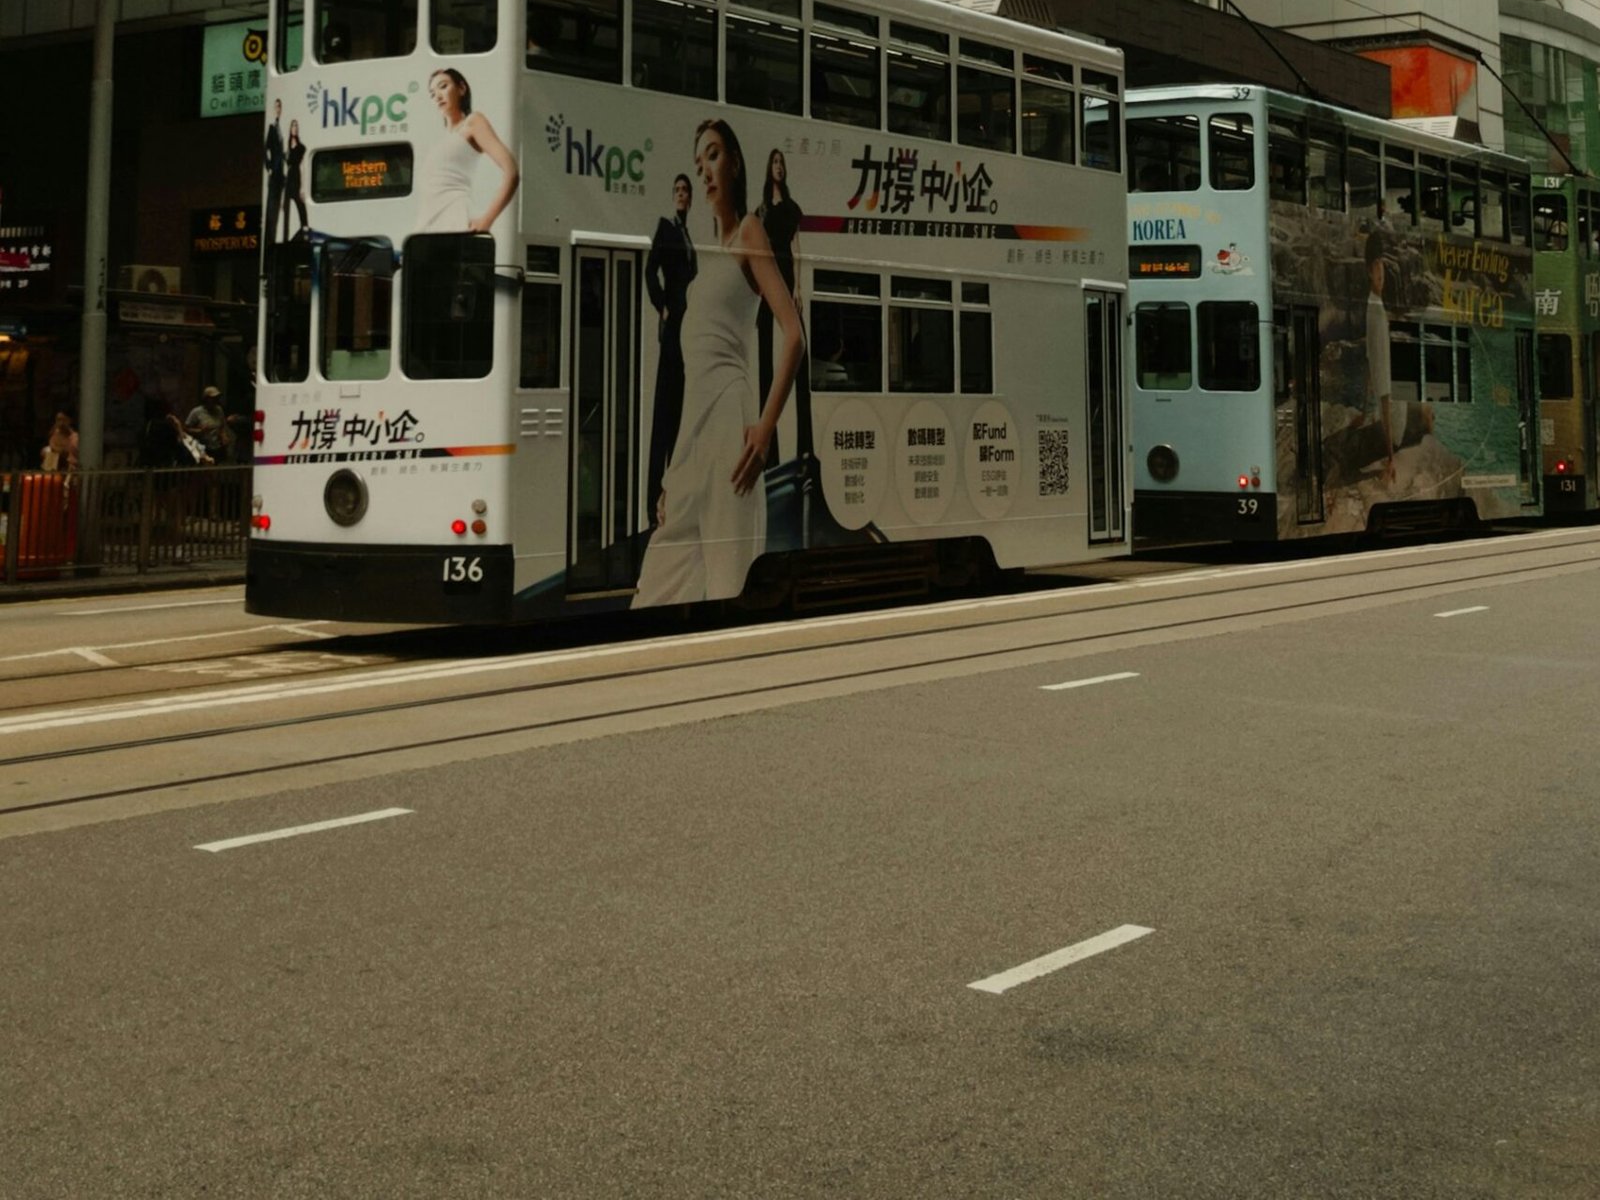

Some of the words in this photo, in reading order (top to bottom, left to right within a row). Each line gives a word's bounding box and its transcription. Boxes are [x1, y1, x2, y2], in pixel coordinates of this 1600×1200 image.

[1232, 87, 1250, 101] 39
[322, 87, 408, 135] hkpc
[341, 160, 389, 174] Western
[565, 126, 645, 192] hkpc
[344, 173, 385, 188] Market
[1543, 177, 1560, 189] 131
[847, 218, 882, 234] HERE
[891, 220, 916, 235] FOR
[925, 221, 966, 237] EVERY
[973, 223, 998, 238] SME
[1132, 218, 1186, 241] KOREA
[1472, 240, 1509, 283] Ending
[1442, 268, 1505, 327] Korea
[1534, 288, 1562, 316] 南
[1559, 479, 1576, 492] 131
[1237, 498, 1259, 515] 39
[442, 556, 483, 582] 136
